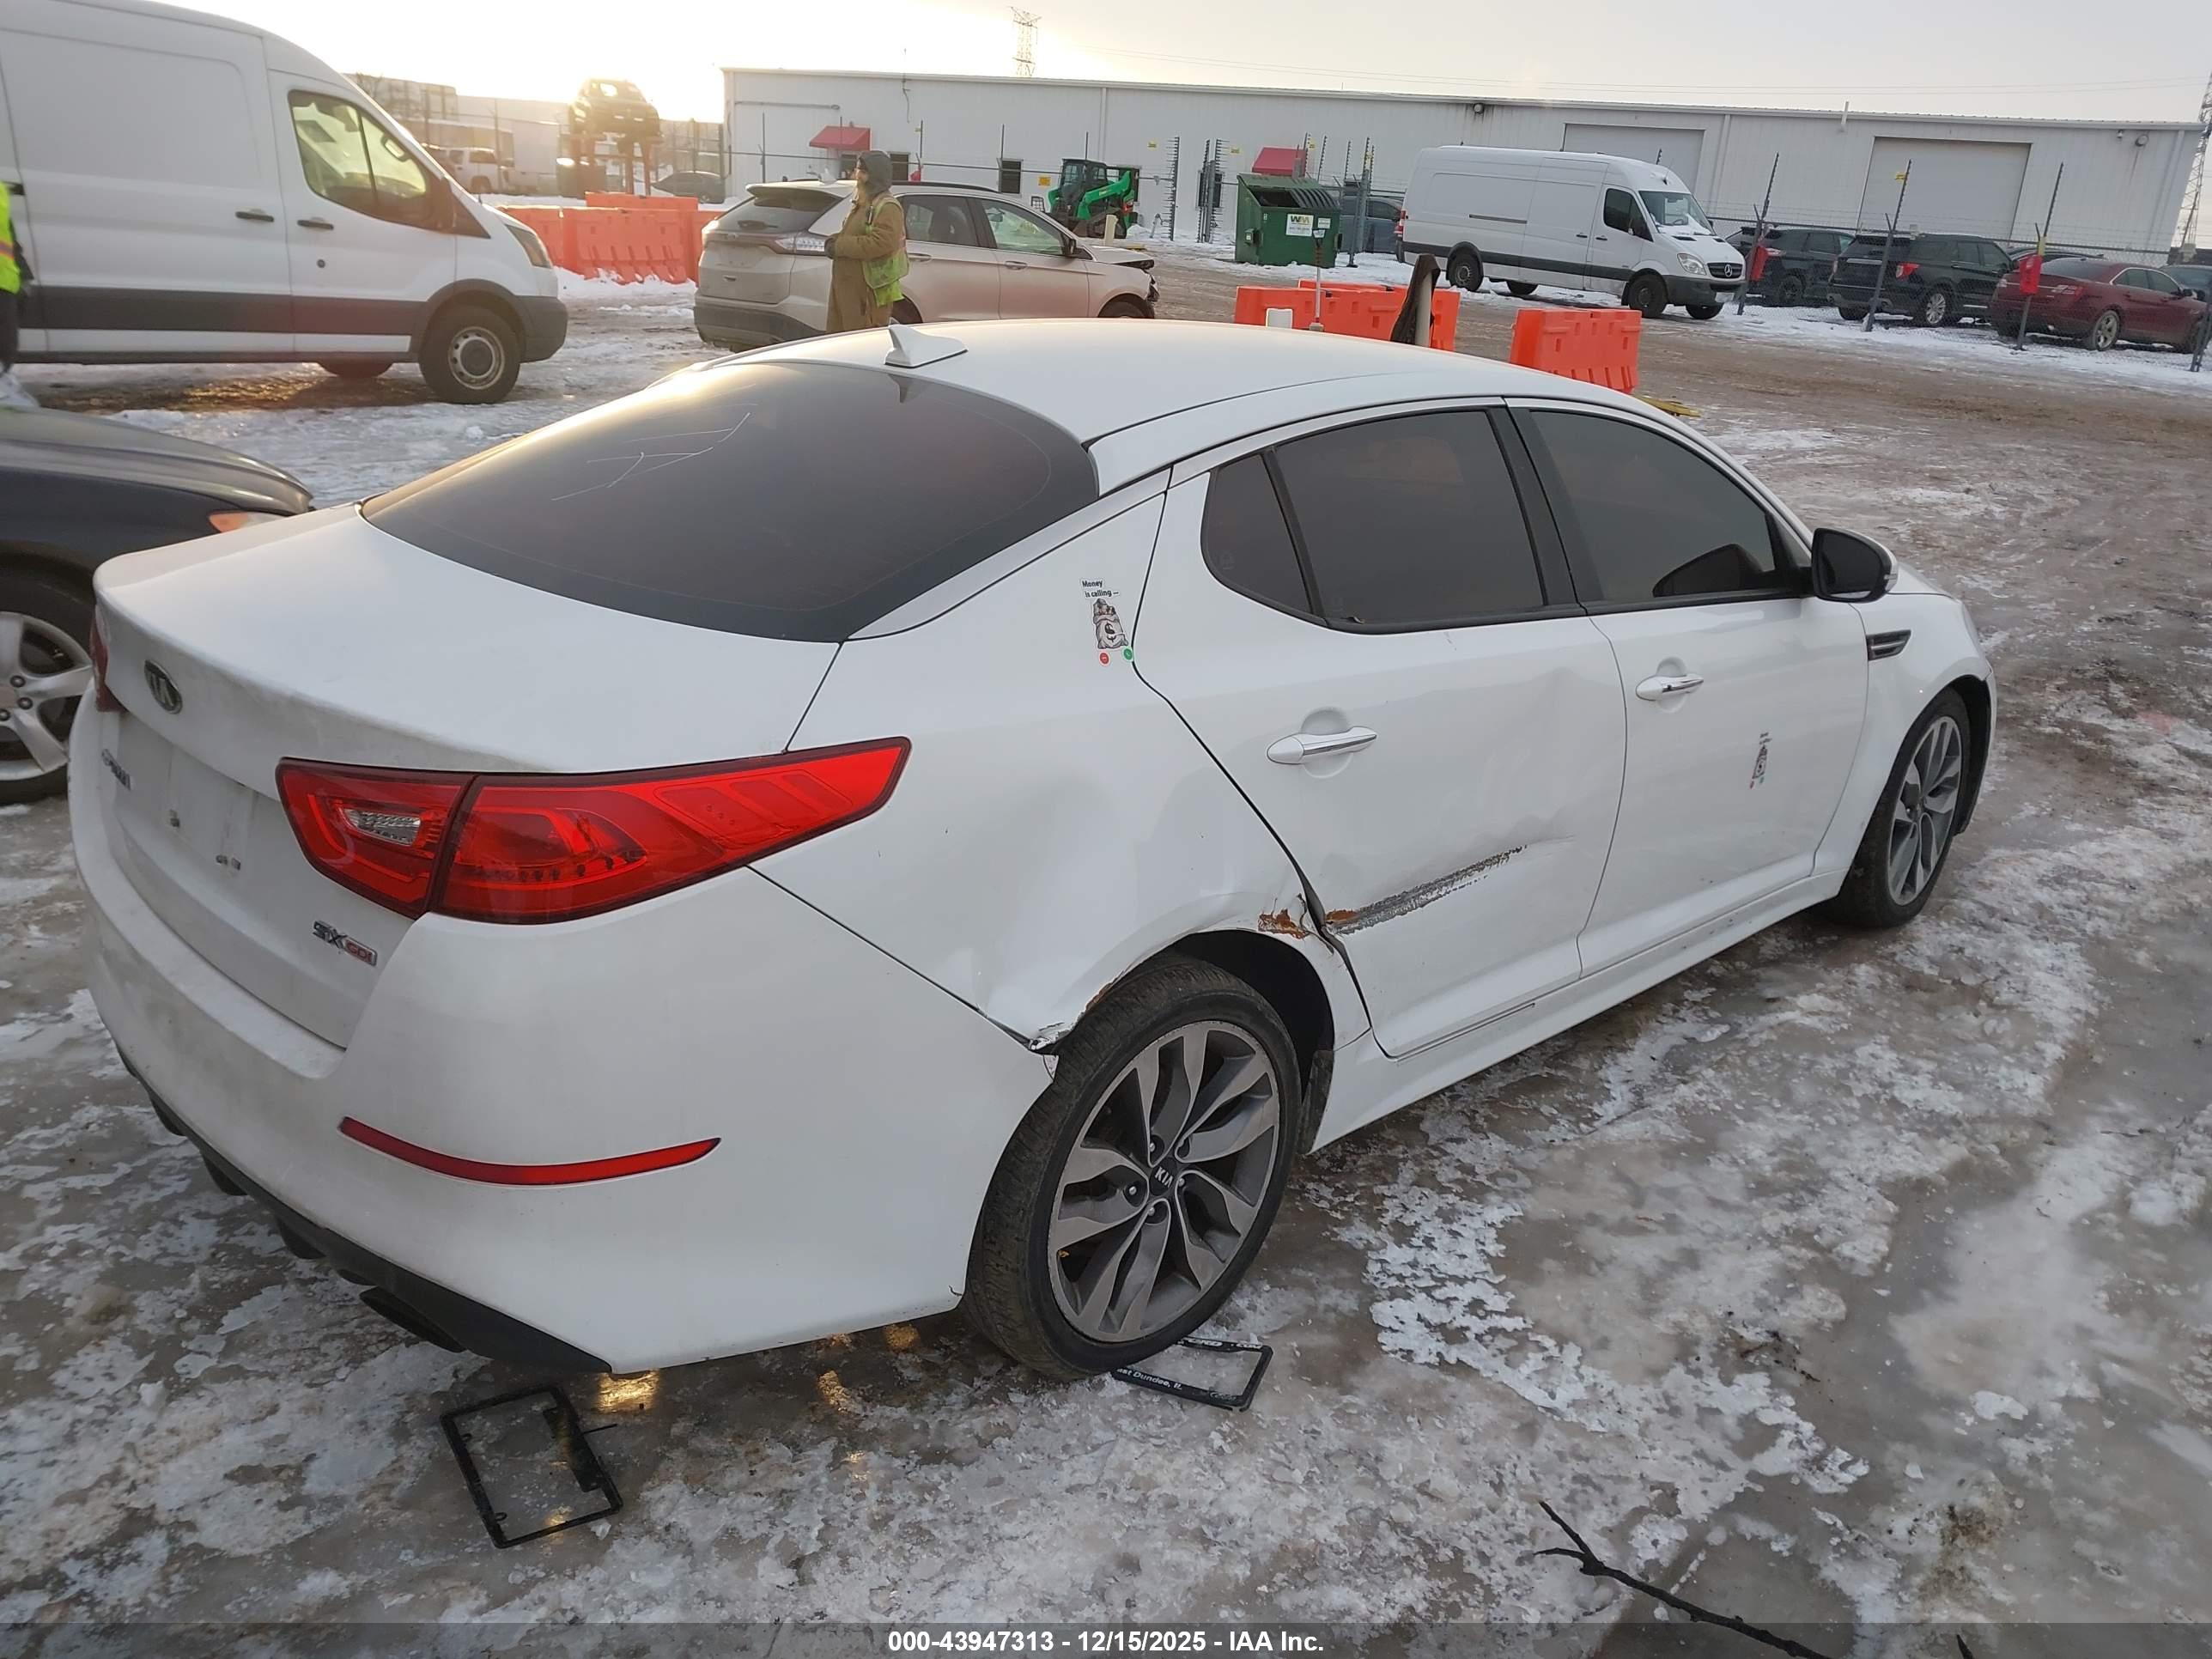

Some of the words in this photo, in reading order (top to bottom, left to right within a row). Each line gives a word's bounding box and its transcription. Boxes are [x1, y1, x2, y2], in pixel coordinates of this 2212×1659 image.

[313, 920, 348, 949] SX
[346, 941, 373, 963] GDI
[1154, 1166, 1175, 1188] KIA
[1116, 1367, 1132, 1376] ast
[1133, 1370, 1171, 1389] Dundee,
